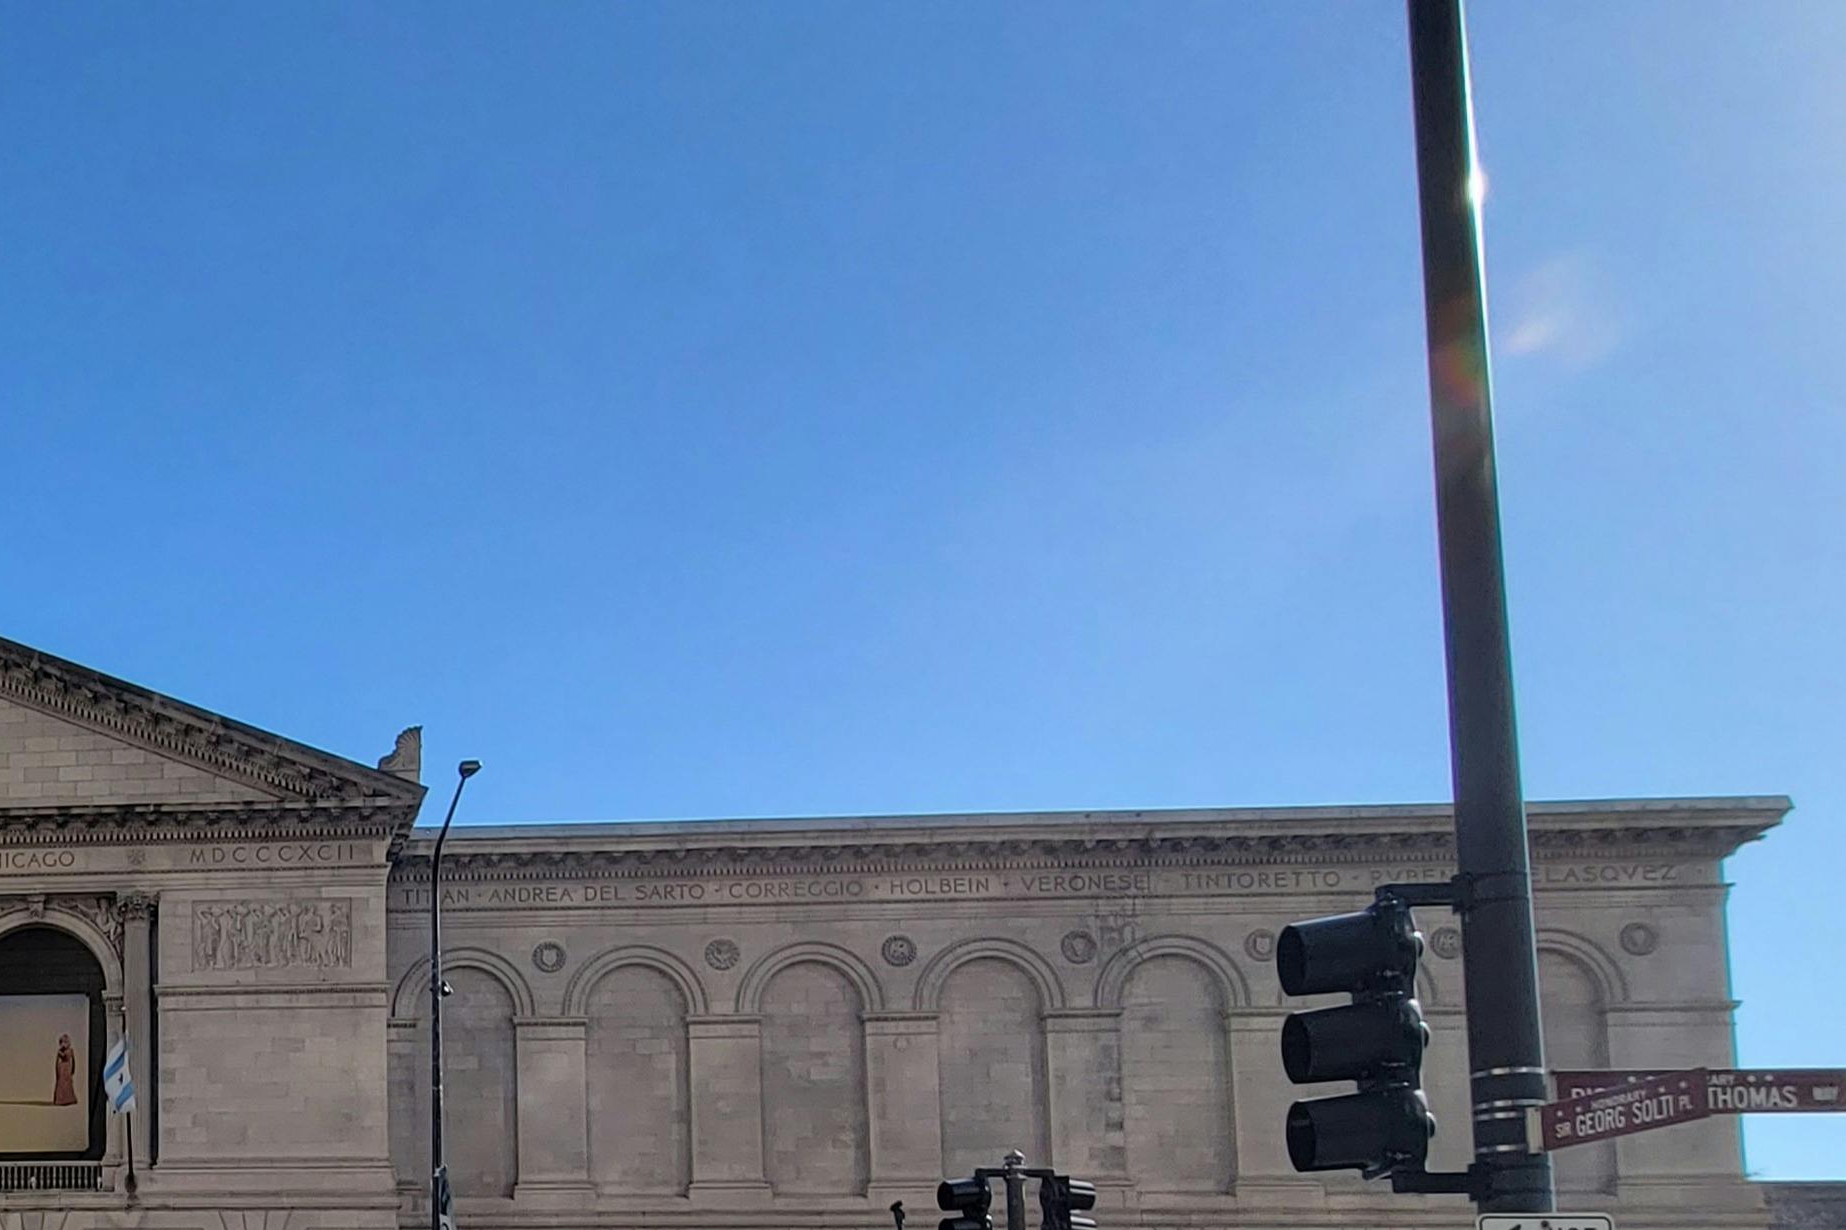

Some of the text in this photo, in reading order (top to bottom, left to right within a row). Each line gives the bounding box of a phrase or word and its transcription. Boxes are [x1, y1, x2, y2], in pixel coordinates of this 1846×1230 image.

[189, 845, 354, 864] MDCCCXCII
[402, 864, 1677, 905] TITAN ANDREA DEL SARTO CORREGGIO HOLBEIN VERONESE TINTORETTO RVBEN ELASQVEZ
[1707, 1086, 1798, 1109] THOMAS
[1575, 1106, 1626, 1137] GEORG
[1632, 1095, 1674, 1124] SOLTI
[1678, 1095, 1694, 1111] PL
